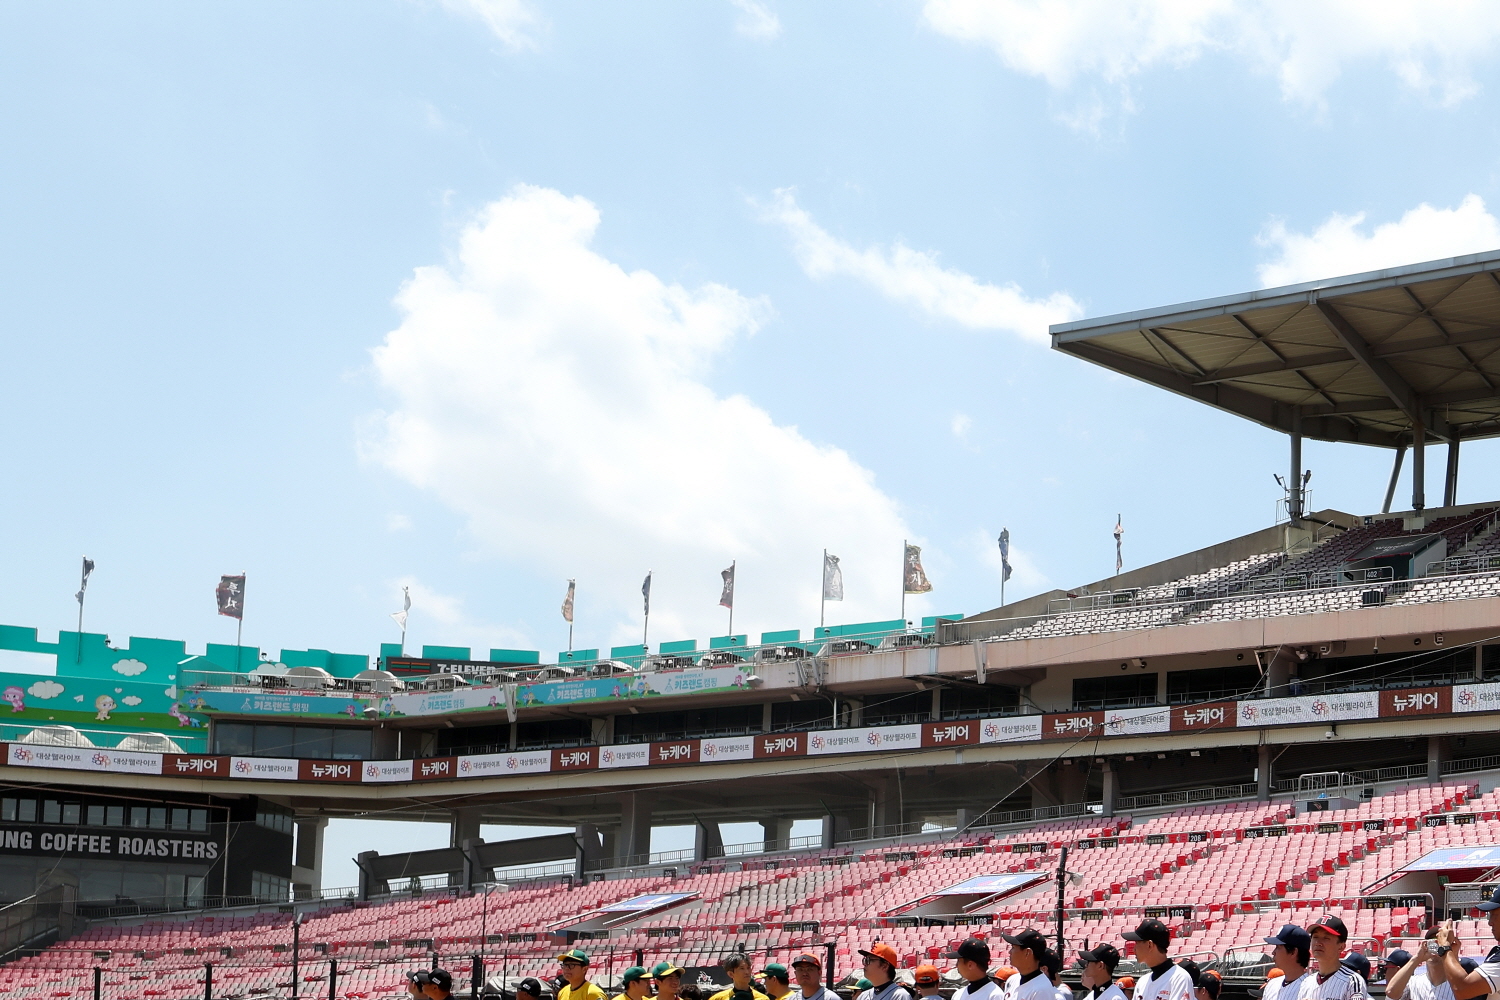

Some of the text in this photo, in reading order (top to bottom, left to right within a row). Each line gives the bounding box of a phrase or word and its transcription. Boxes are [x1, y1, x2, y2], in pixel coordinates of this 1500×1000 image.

[1393, 692, 1438, 711] 뉴케어
[1183, 707, 1224, 725] 뉴케어
[932, 724, 969, 742] 뉴케어
[658, 744, 691, 760] 뉴케어
[764, 737, 797, 753] 뉴케어
[176, 758, 218, 773] 뉴케어
[312, 764, 351, 778] 뉴케어
[421, 761, 449, 776] 뉴케어
[1365, 822, 1378, 831] 209
[1427, 818, 1440, 827] 307
[40, 832, 111, 853] COFFEE
[118, 837, 218, 860] ROASTERS
[1321, 914, 1332, 925] T
